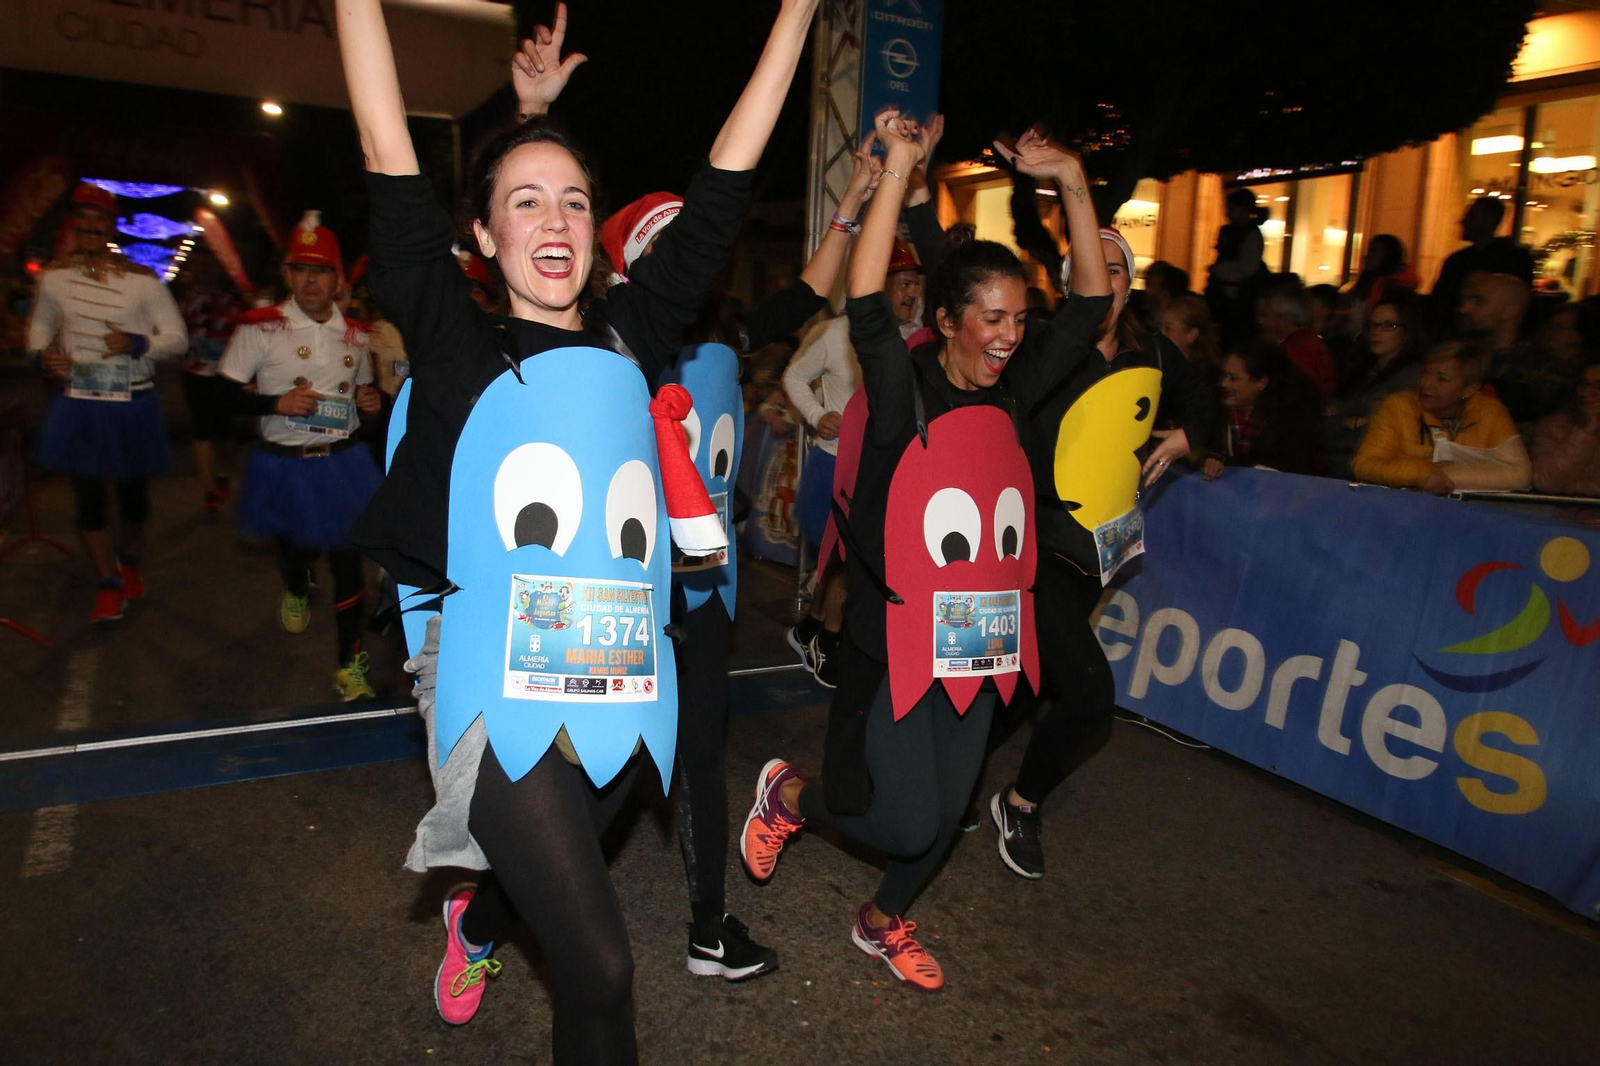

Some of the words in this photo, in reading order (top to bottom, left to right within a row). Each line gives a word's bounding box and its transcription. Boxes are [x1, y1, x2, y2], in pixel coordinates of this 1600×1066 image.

[55, 10, 206, 57] CIUDAD
[890, 81, 910, 92] OPEL
[635, 233, 645, 244] La
[642, 221, 654, 234] Voz
[653, 214, 663, 222] de
[318, 405, 347, 419] 1902
[597, 587, 615, 602] SAN
[580, 603, 613, 613] CIUDAD
[614, 605, 624, 613] DE
[577, 615, 649, 646] 1374
[978, 615, 1015, 637] 1403
[519, 655, 550, 663] ALMERÍA
[566, 648, 605, 665] MARIA
[608, 649, 645, 665] ESTHER
[1093, 589, 1548, 815] eportes
